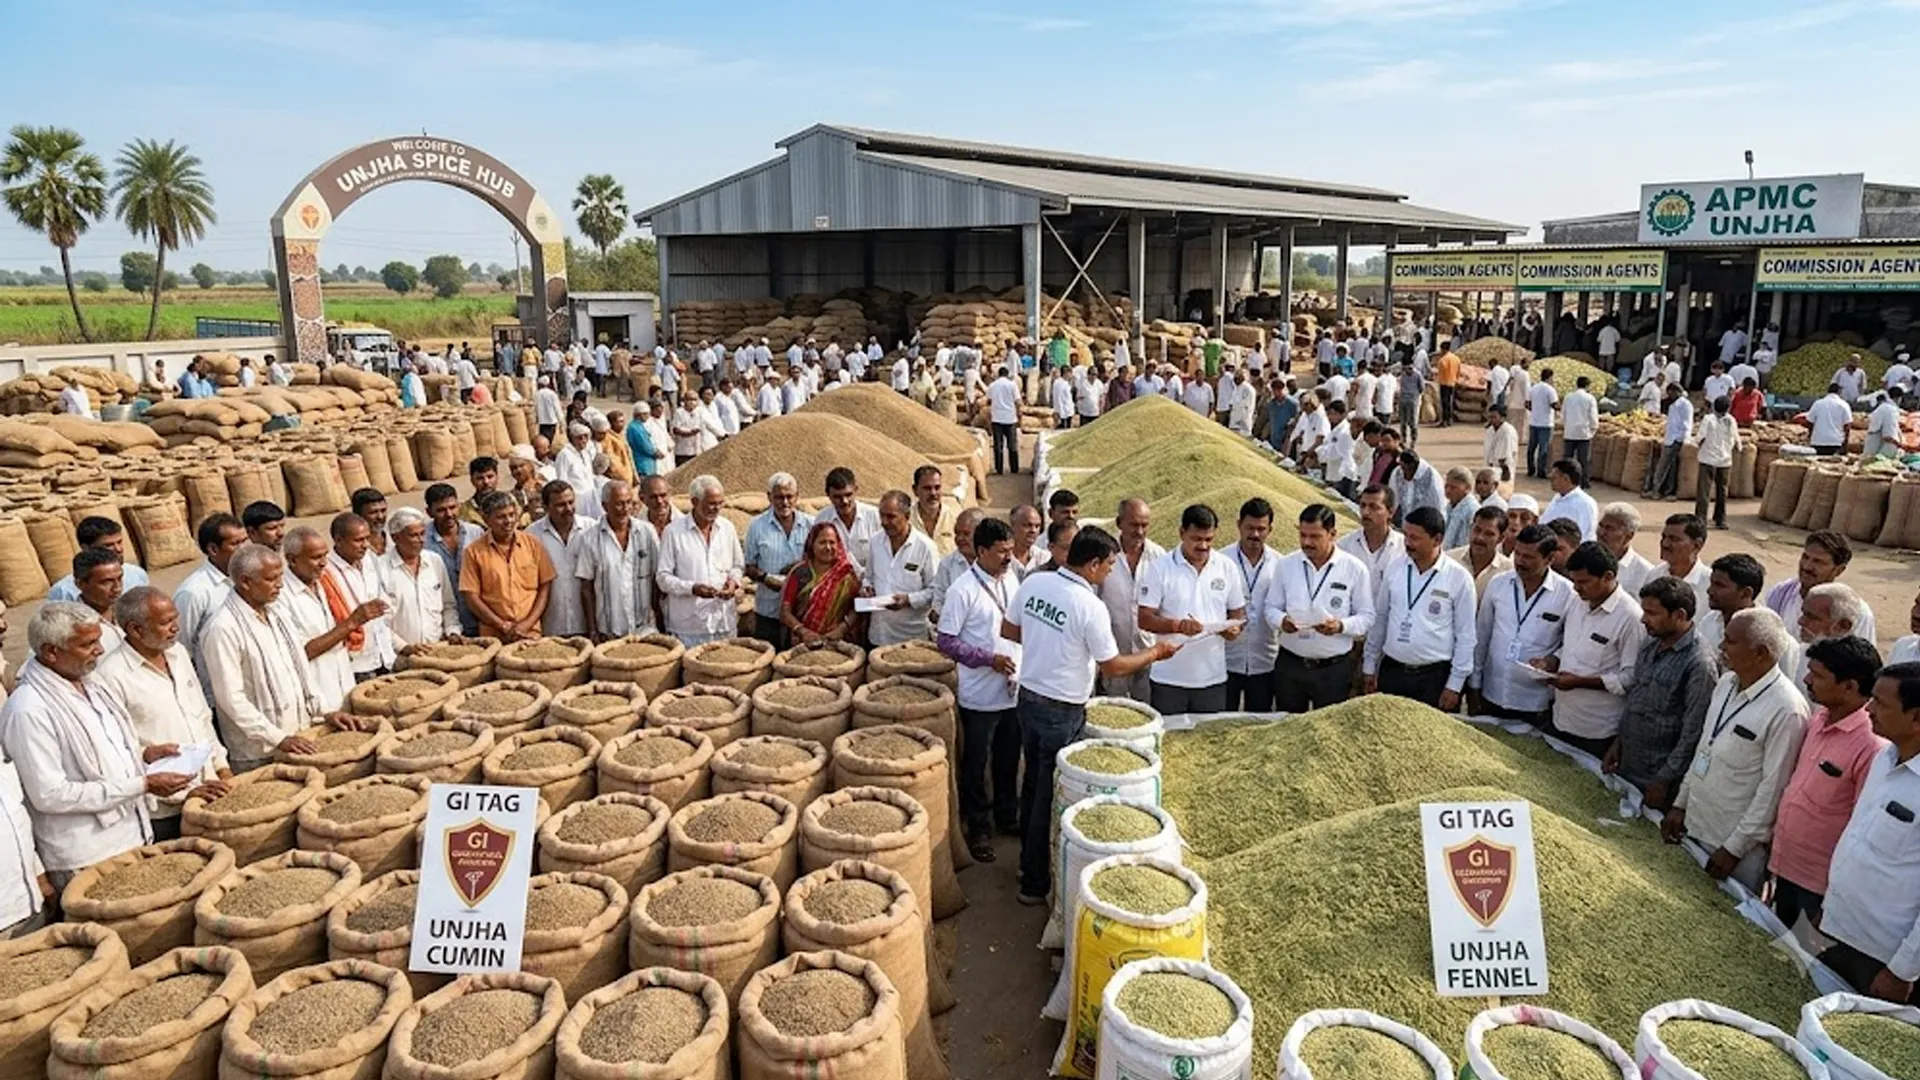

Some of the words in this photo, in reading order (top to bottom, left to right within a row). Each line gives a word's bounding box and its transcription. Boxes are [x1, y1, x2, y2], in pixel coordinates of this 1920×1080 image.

[450, 144, 466, 155] TO
[336, 154, 408, 192] UNJHA
[412, 152, 471, 176] SPICE
[475, 165, 515, 198] HUB
[1704, 183, 1818, 212] APMC
[1710, 214, 1816, 236] UNJHA
[1394, 264, 1465, 277] COMMISSION
[1467, 263, 1515, 277] AGENTS
[1520, 264, 1602, 278] COMMISSION
[1605, 263, 1659, 277] AGENTS
[1763, 259, 1865, 274] COMMISSION
[1025, 595, 1067, 626] APMC
[447, 792, 470, 811] GI
[476, 793, 520, 812] TAG
[1439, 810, 1462, 829] GI
[1468, 808, 1514, 828] TAG
[467, 831, 489, 849] GI
[1468, 849, 1490, 867] GI
[430, 918, 507, 941] UNJHA
[427, 945, 505, 967] CUMIN
[1451, 941, 1529, 961] UNJHA
[1448, 968, 1538, 988] FENNEL
